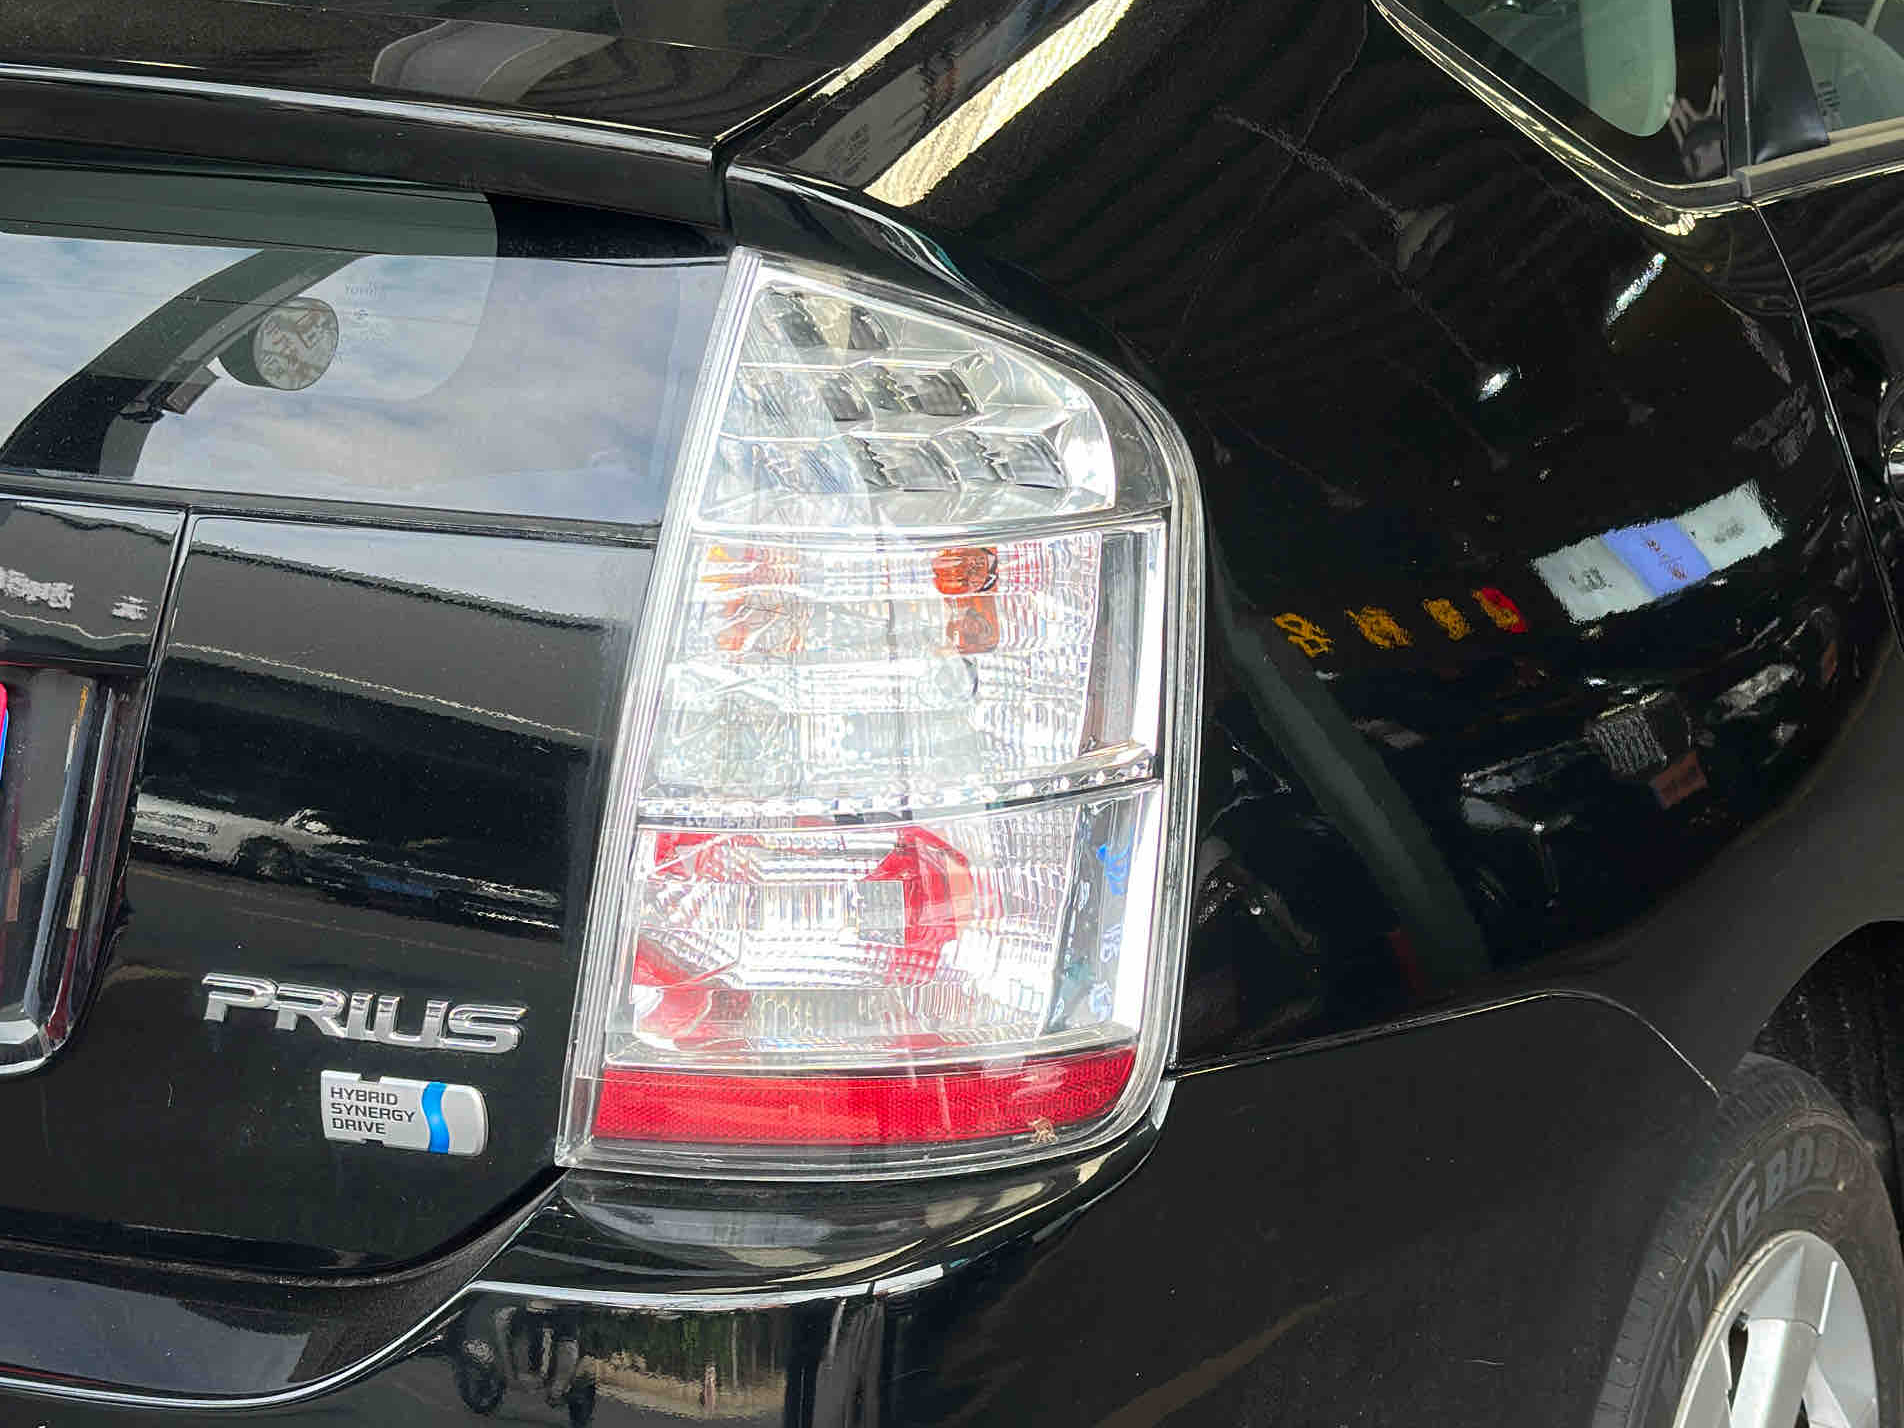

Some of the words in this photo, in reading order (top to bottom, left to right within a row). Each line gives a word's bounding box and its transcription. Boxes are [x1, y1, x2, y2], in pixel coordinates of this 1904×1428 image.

[201, 972, 529, 1054] PRIUS
[329, 1085, 399, 1107] HYBRID
[329, 1102, 416, 1123] SYNERGY
[331, 1117, 386, 1135] DRIVE
